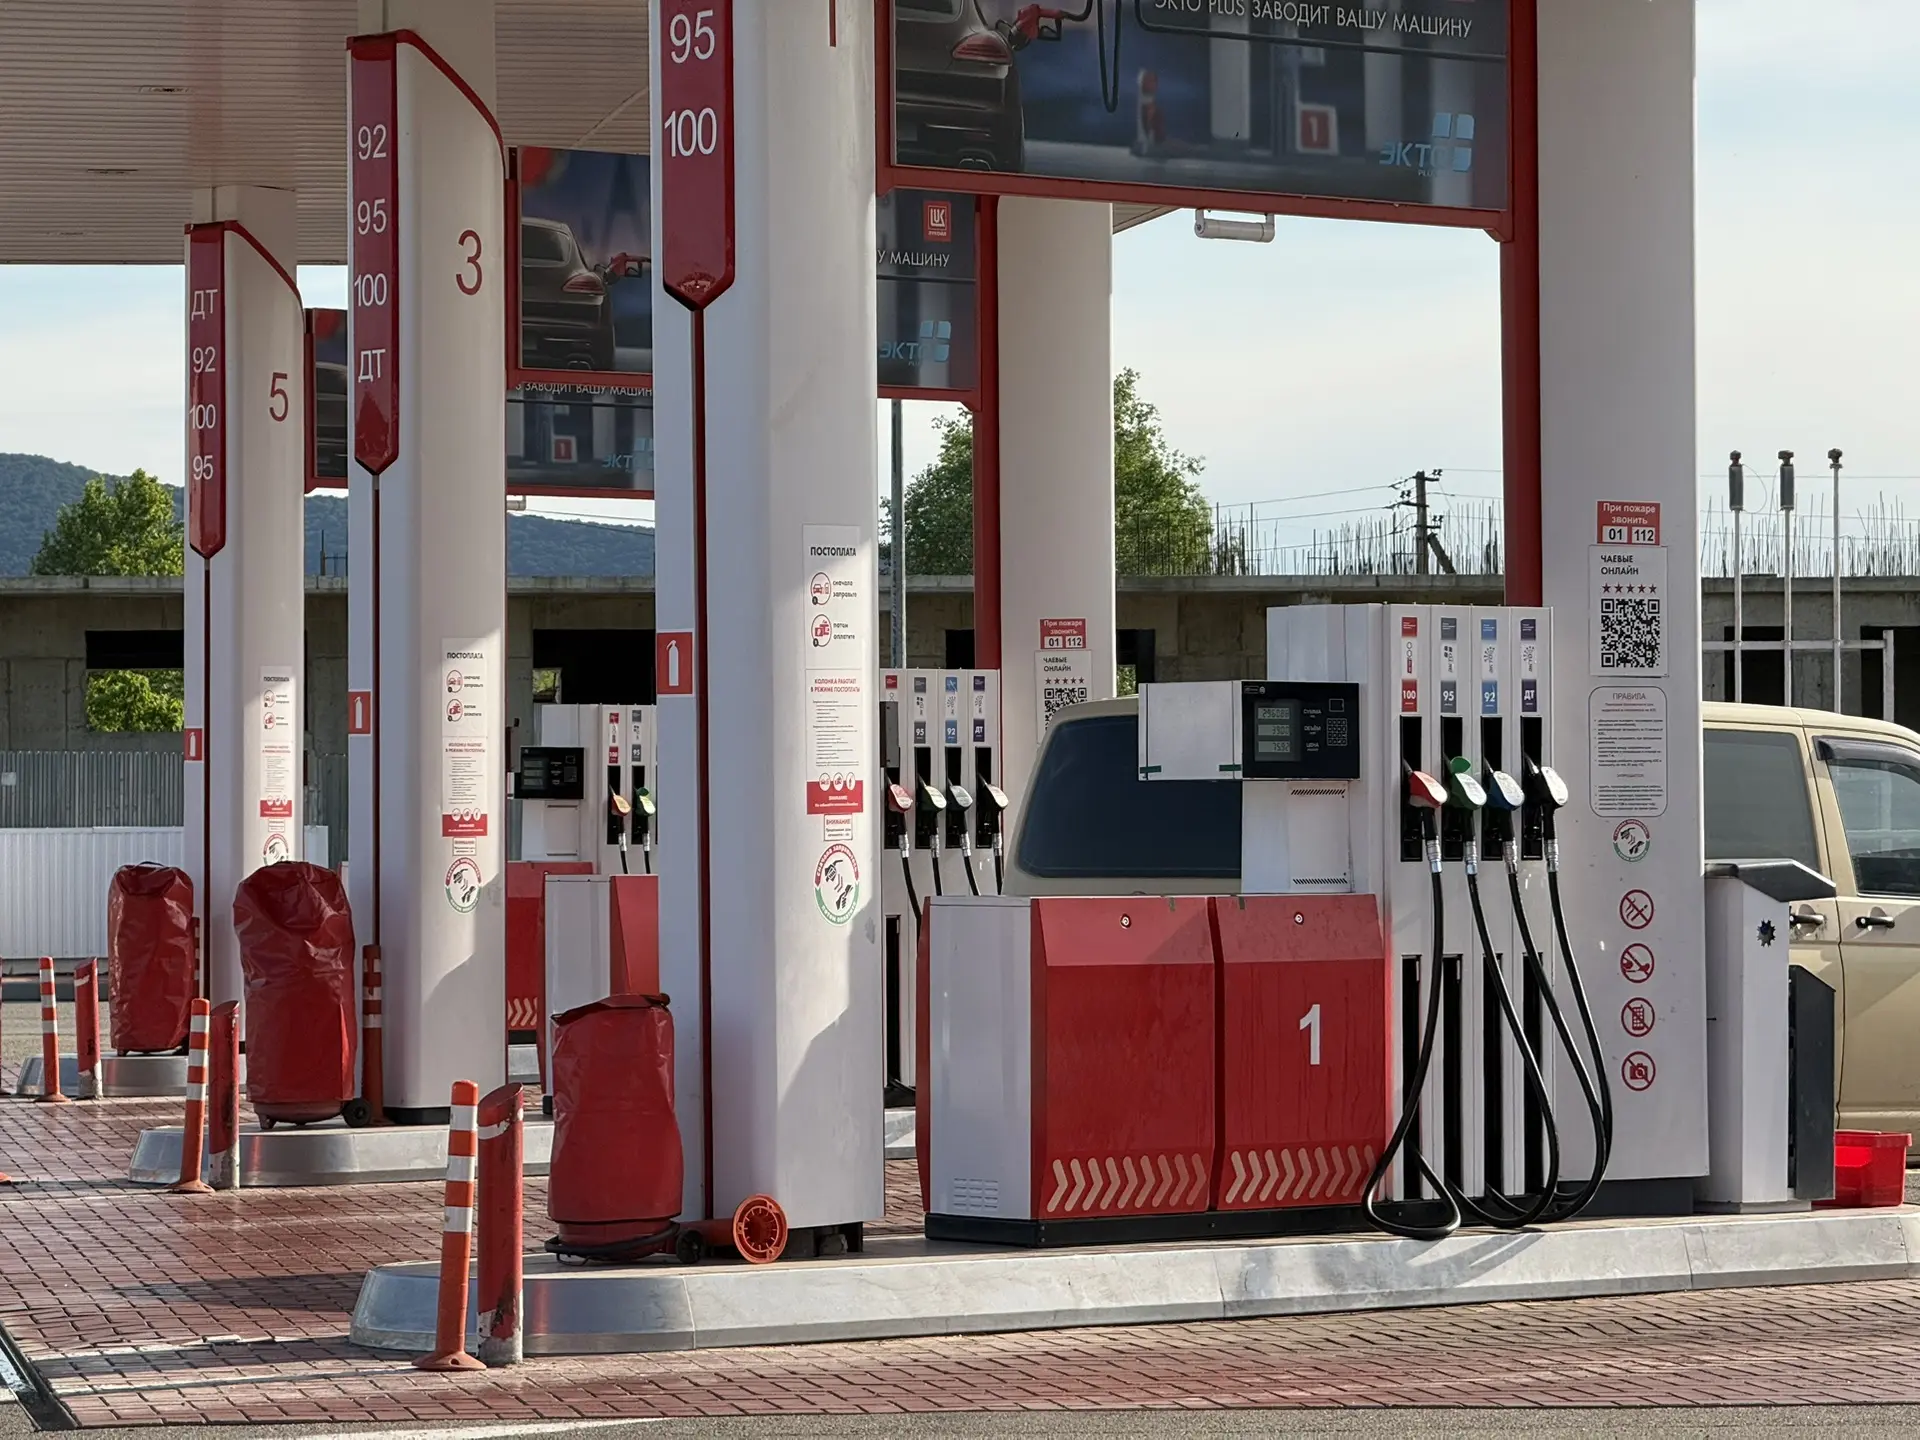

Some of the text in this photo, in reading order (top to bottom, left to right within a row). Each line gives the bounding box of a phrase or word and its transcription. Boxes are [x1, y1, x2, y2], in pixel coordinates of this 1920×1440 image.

[1208, 0, 1245, 16] PLUS
[1252, 0, 1329, 28] ЗАВОДИТ
[1336, 11, 1387, 30] ВАШУ
[1392, 15, 1473, 38] МАШИНУ
[669, 9, 716, 64] 95
[664, 107, 717, 157] 100
[1308, 117, 1318, 142] 1
[358, 124, 387, 160] 92
[357, 199, 387, 235] 95
[456, 229, 483, 296] 3
[890, 251, 950, 268] МАШИНУ
[354, 273, 387, 307] 100
[191, 288, 218, 321] ДТ
[193, 346, 216, 374] 92
[357, 348, 386, 383] ДТ
[269, 371, 289, 422] 5
[610, 386, 653, 397] МАШИН
[189, 404, 216, 430] 100
[193, 455, 214, 481] 95
[1602, 502, 1656, 515] При пожаре
[1611, 515, 1648, 525] звонить
[1608, 528, 1654, 542] 01 112
[810, 546, 857, 557] ПОСТОПЛАТА
[1600, 555, 1634, 563] ЧАЕВЫЕ
[1600, 565, 1639, 576] ОНЛАЙН
[1048, 637, 1082, 647] 01 112
[1402, 690, 1417, 700] 100
[1442, 690, 1455, 702] 95
[1484, 691, 1496, 703] 92
[1523, 689, 1535, 701] ДТ
[1612, 692, 1646, 701] ПРАВИЛА
[915, 728, 925, 736] 95
[947, 727, 956, 736] 92
[633, 748, 641, 756] 95
[1299, 1003, 1321, 1066] 1
